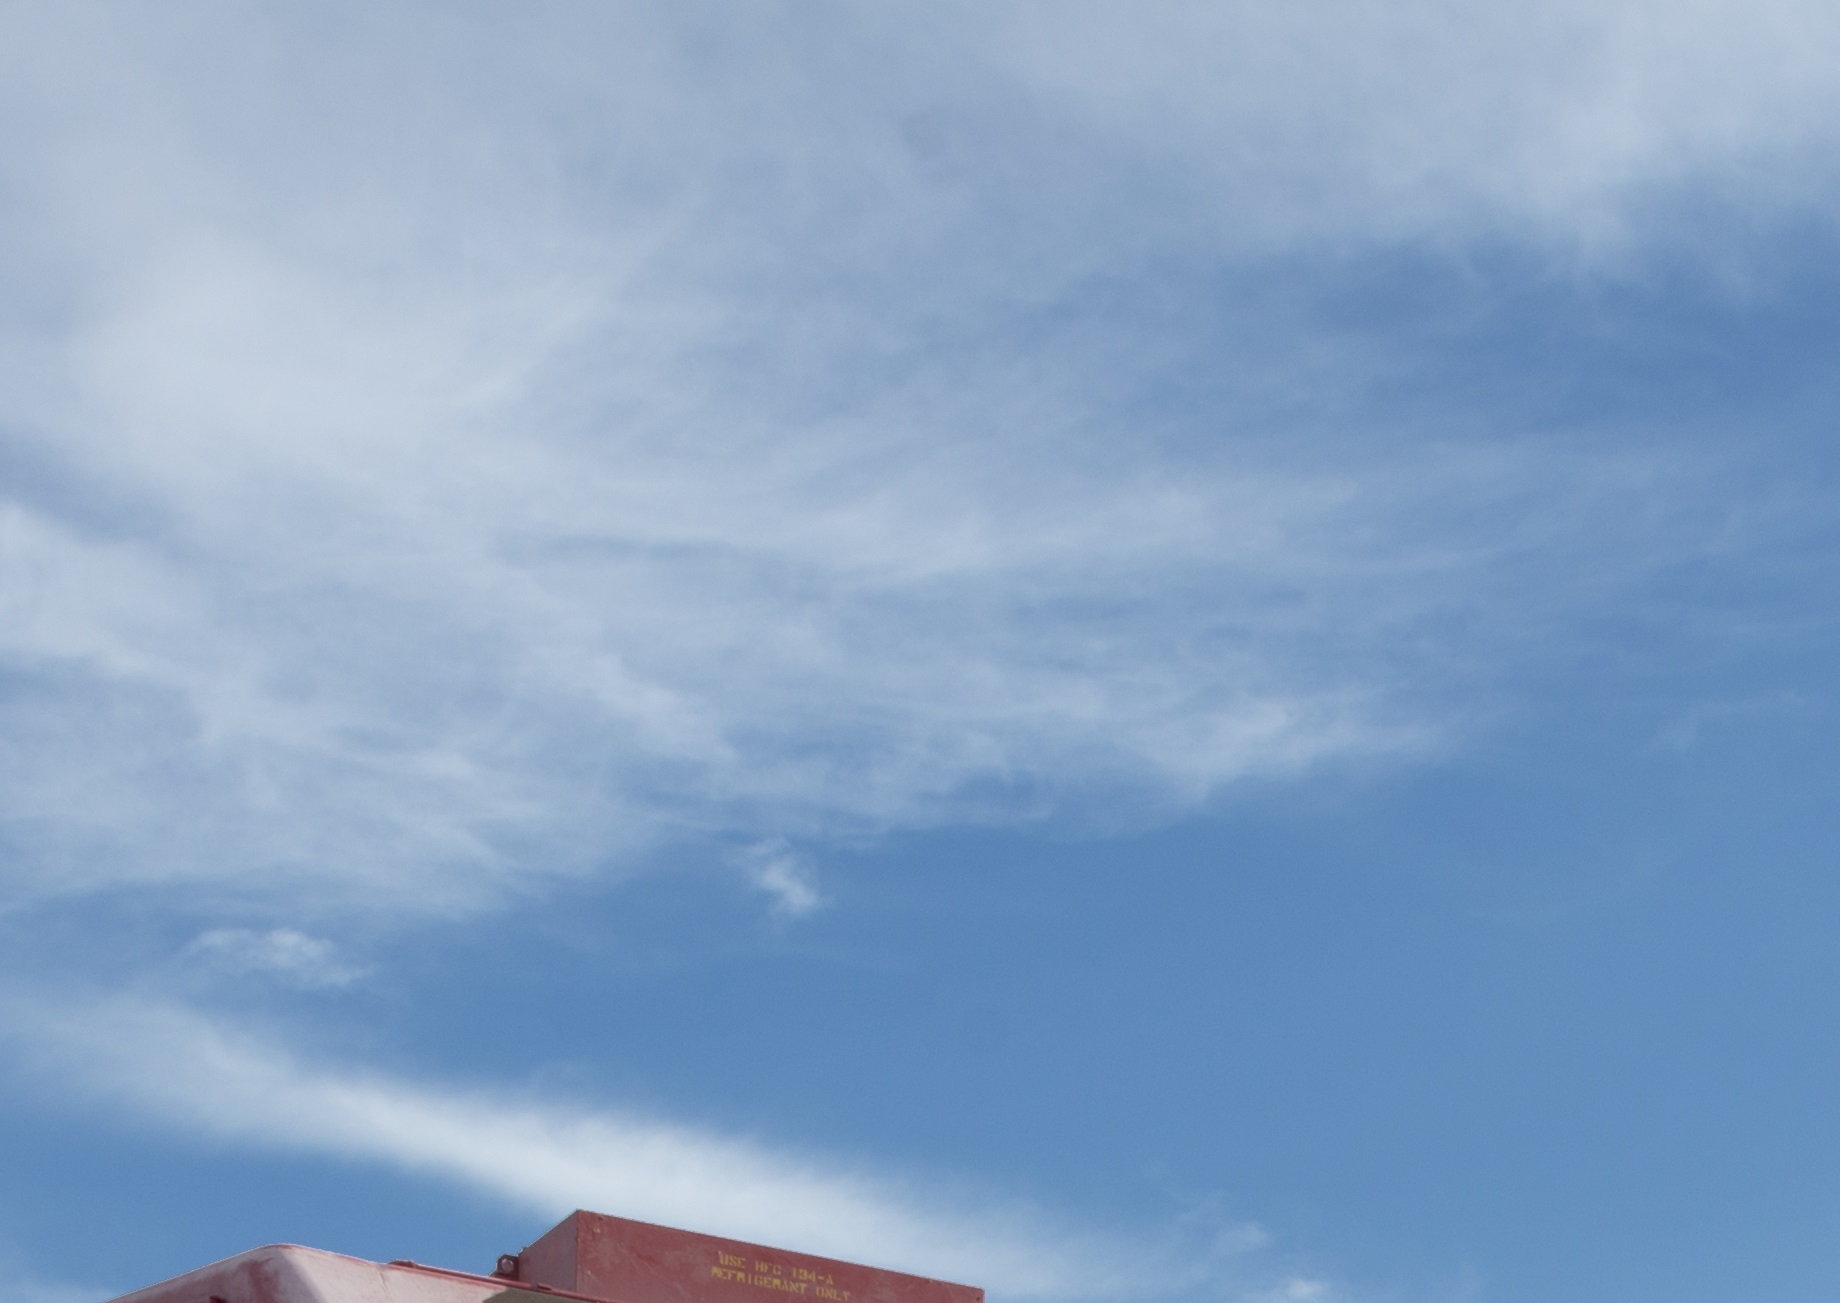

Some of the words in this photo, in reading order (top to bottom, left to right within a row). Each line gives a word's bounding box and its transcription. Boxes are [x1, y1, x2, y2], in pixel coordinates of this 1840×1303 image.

[755, 1260, 782, 1276] HFC
[711, 1266, 807, 1295] REFRIGERANT
[815, 1285, 850, 1302] ONLY
